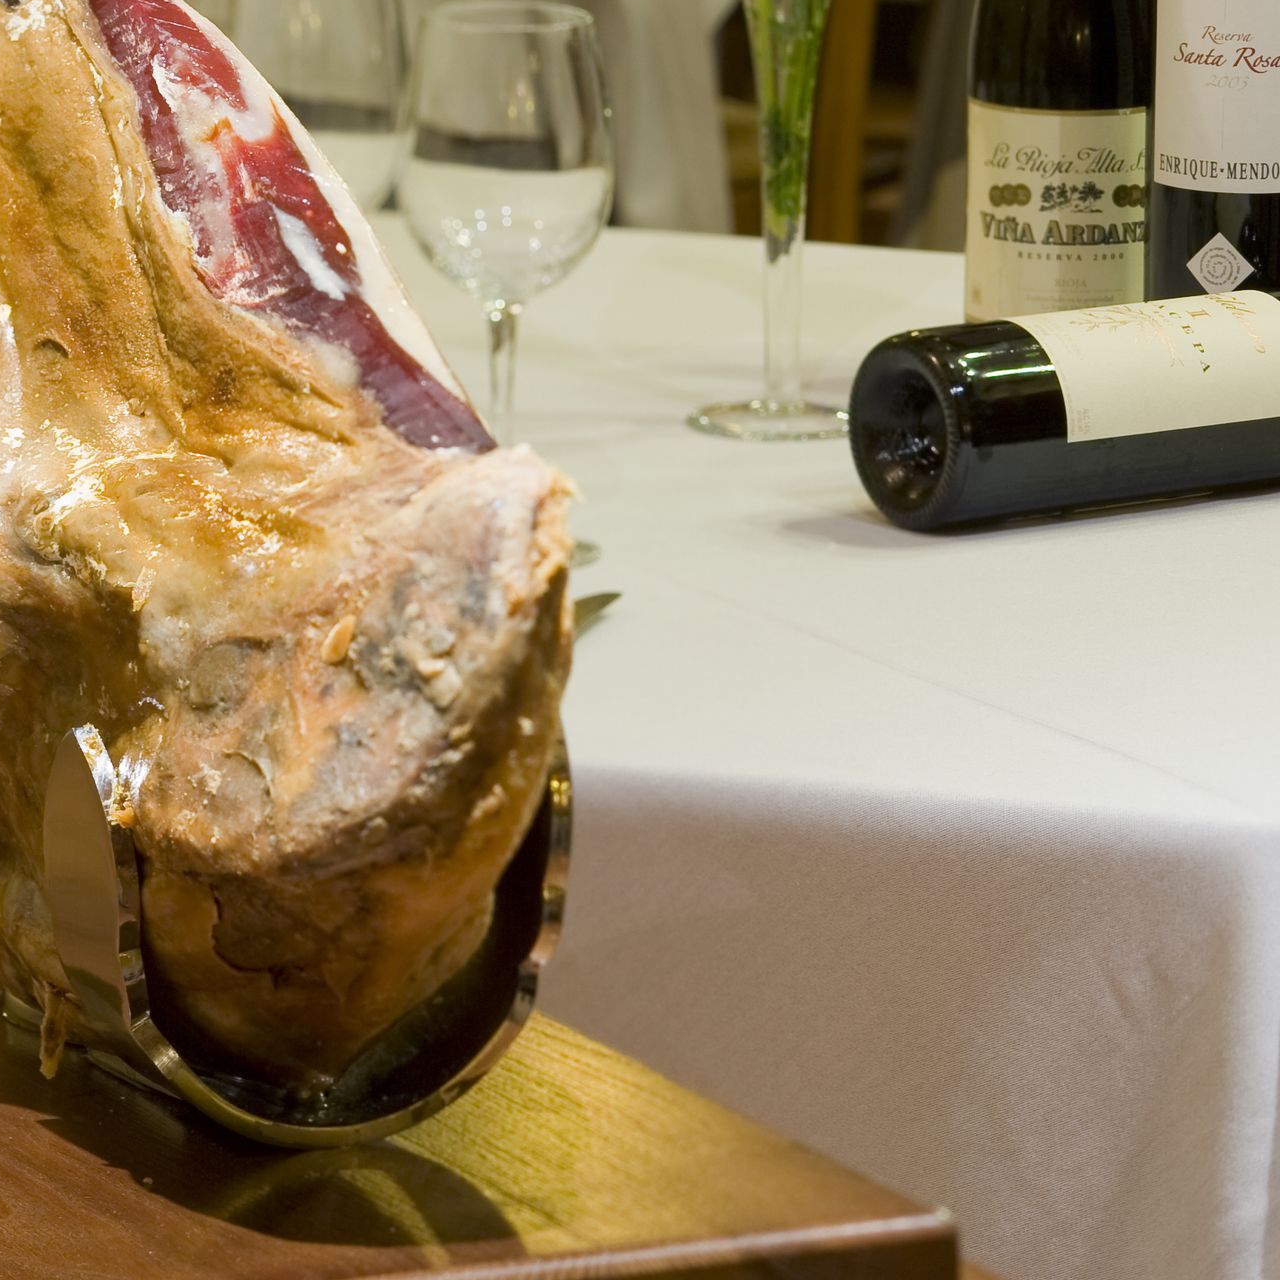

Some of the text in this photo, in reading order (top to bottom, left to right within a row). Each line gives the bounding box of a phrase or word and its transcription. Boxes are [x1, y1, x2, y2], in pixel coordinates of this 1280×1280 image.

[1201, 25, 1254, 45] Reserva
[1173, 42, 1228, 68] Santa
[984, 142, 1011, 169] La
[1015, 145, 1074, 179] Rioja
[1159, 153, 1219, 181] ENRIQUE
[980, 210, 1149, 246] VIÑA ARDANZ
[1018, 251, 1125, 262] RESERVA 2000
